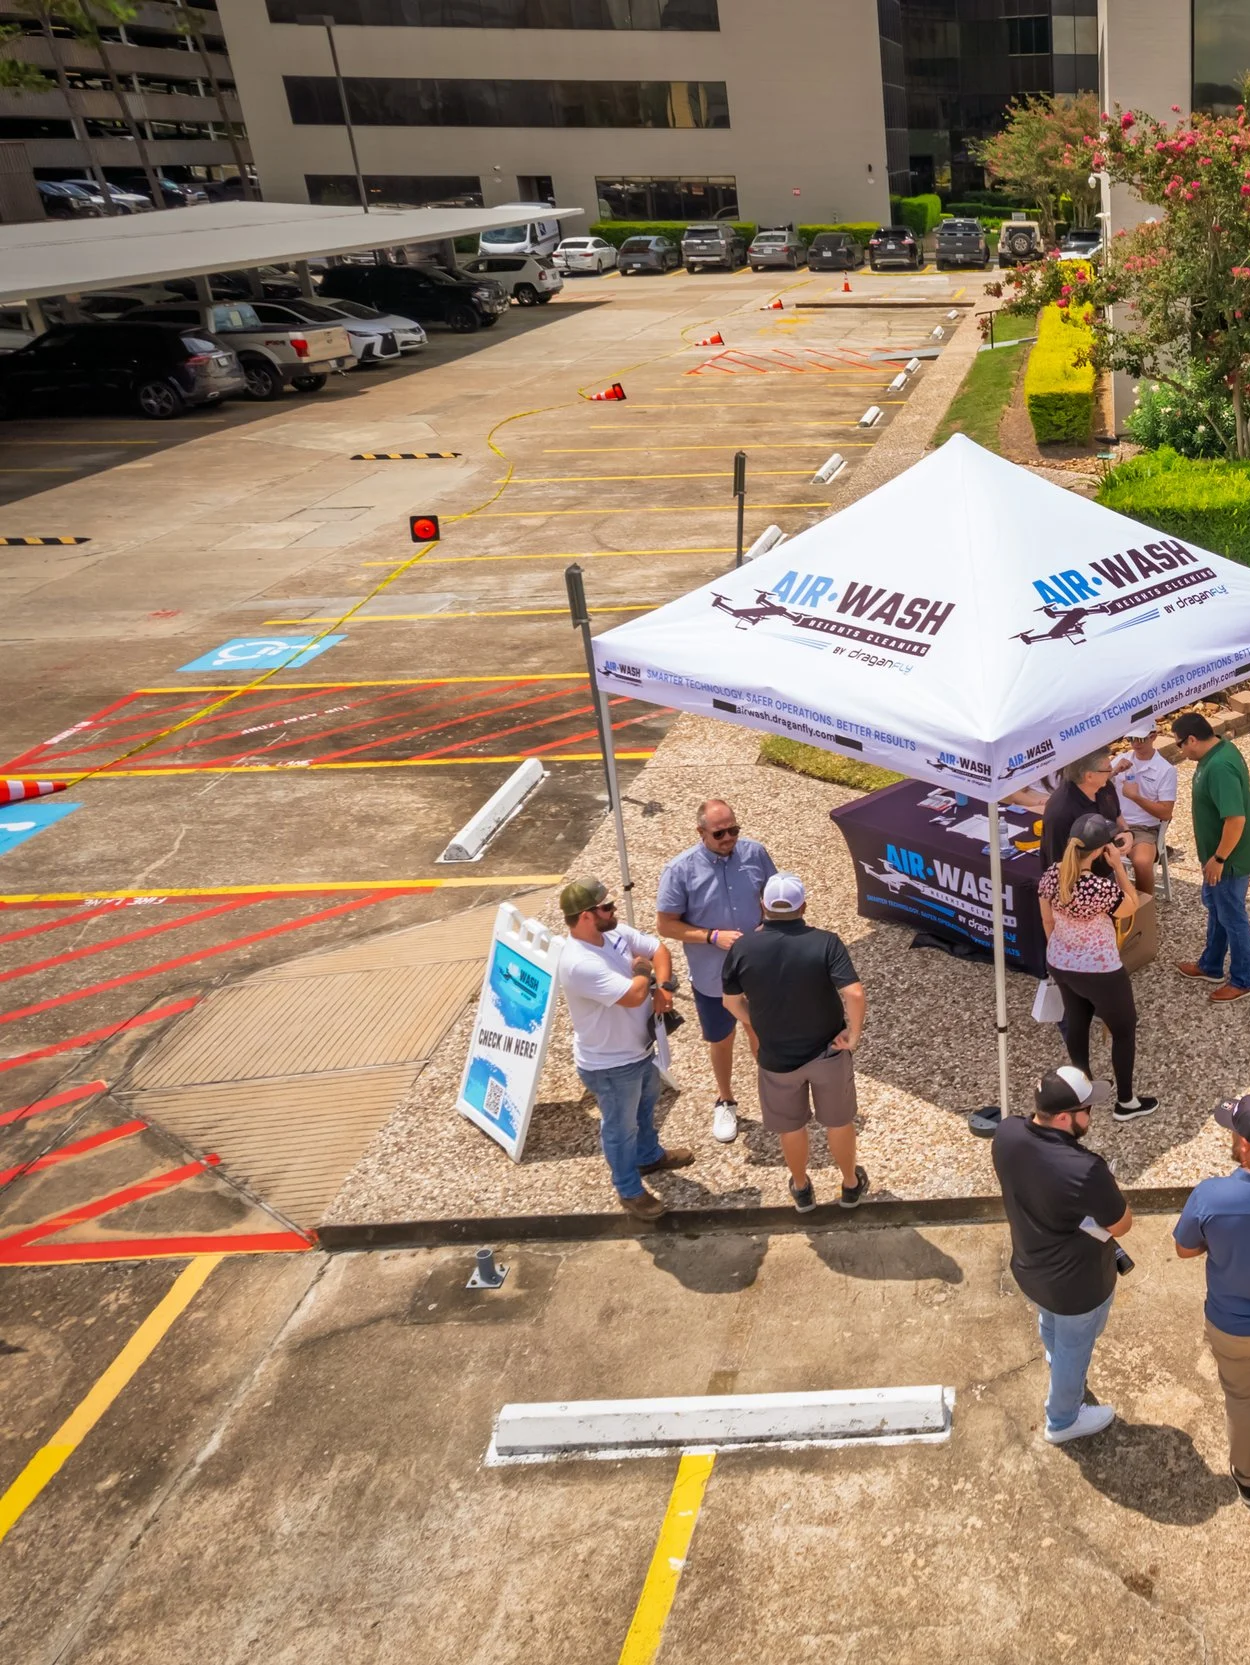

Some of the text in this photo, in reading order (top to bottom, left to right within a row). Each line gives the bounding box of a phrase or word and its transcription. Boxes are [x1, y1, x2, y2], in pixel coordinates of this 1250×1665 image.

[1115, 570, 1215, 609] HEIGHTS CLEANING
[1163, 604, 1175, 614] BY
[808, 619, 928, 655] HEIGHTS CLEANING
[832, 646, 846, 655] BY
[1059, 714, 1102, 742] SMARTER
[1102, 687, 1161, 722] TECHNOLOGY.
[1161, 674, 1185, 693] SAFER
[1186, 656, 1234, 682] OPERATIONS.
[1153, 669, 1236, 712] airwash.draganfly.com
[646, 669, 684, 687] SMARTER
[685, 678, 745, 701] TECHNOLOGY.
[746, 693, 773, 708] SAFER
[775, 700, 834, 727] OPERATIONS.
[836, 719, 872, 738] BETTER
[873, 730, 917, 751] RESULTS
[736, 706, 836, 742] airwash.draganfly.com
[931, 891, 965, 908] HEIGHTS
[478, 1028, 538, 1059] CHECK IN HERE!
